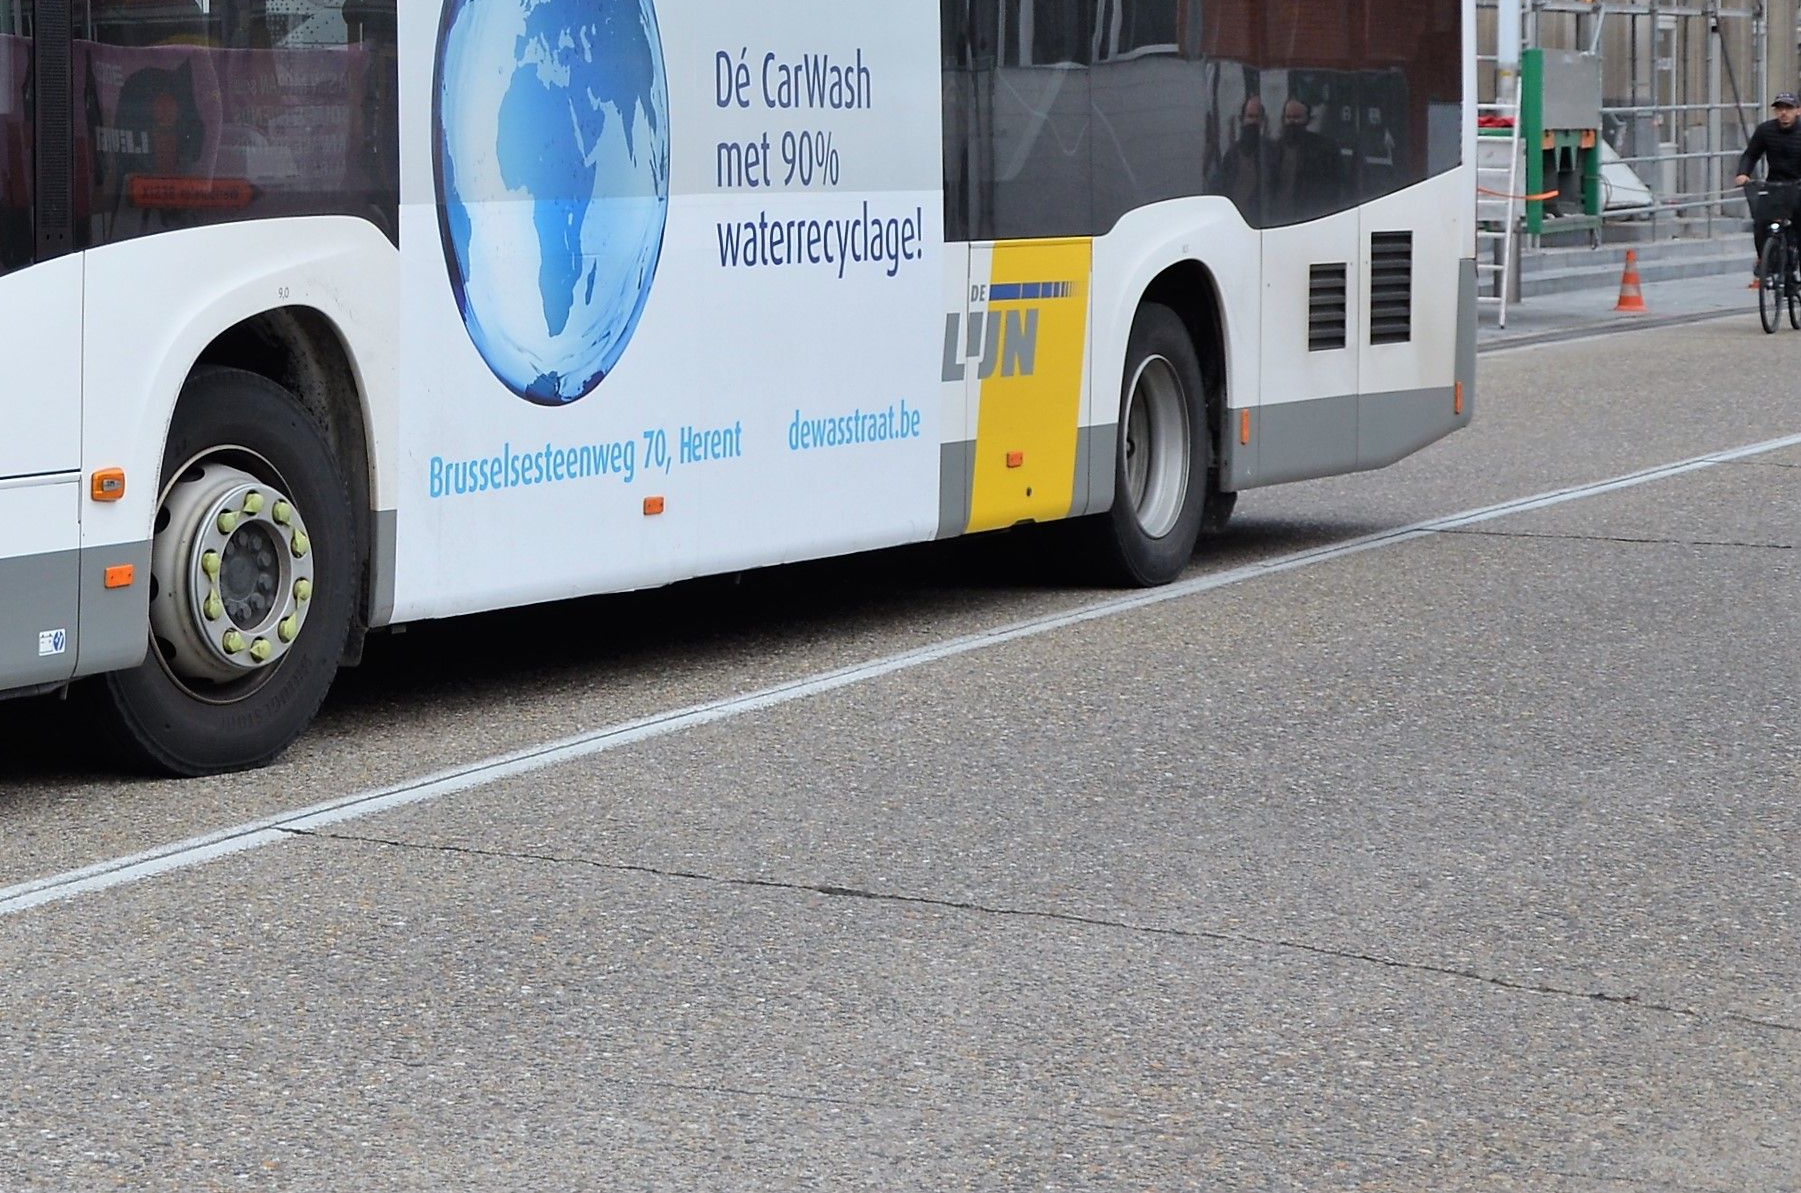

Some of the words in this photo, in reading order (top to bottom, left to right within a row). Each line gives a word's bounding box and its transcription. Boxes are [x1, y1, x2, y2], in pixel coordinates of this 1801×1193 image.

[715, 46, 750, 108] Dé
[762, 48, 871, 109] CarWash
[716, 131, 771, 187] met
[781, 130, 840, 187] 90%
[716, 200, 922, 279] waterrecyclage!
[970, 284, 987, 302] DE
[941, 308, 1039, 382] LIJN
[789, 399, 920, 451] dewasstraat.be
[430, 429, 636, 498] Brusselsesteenweg
[643, 428, 673, 475] 70,
[680, 420, 743, 465] Herent
